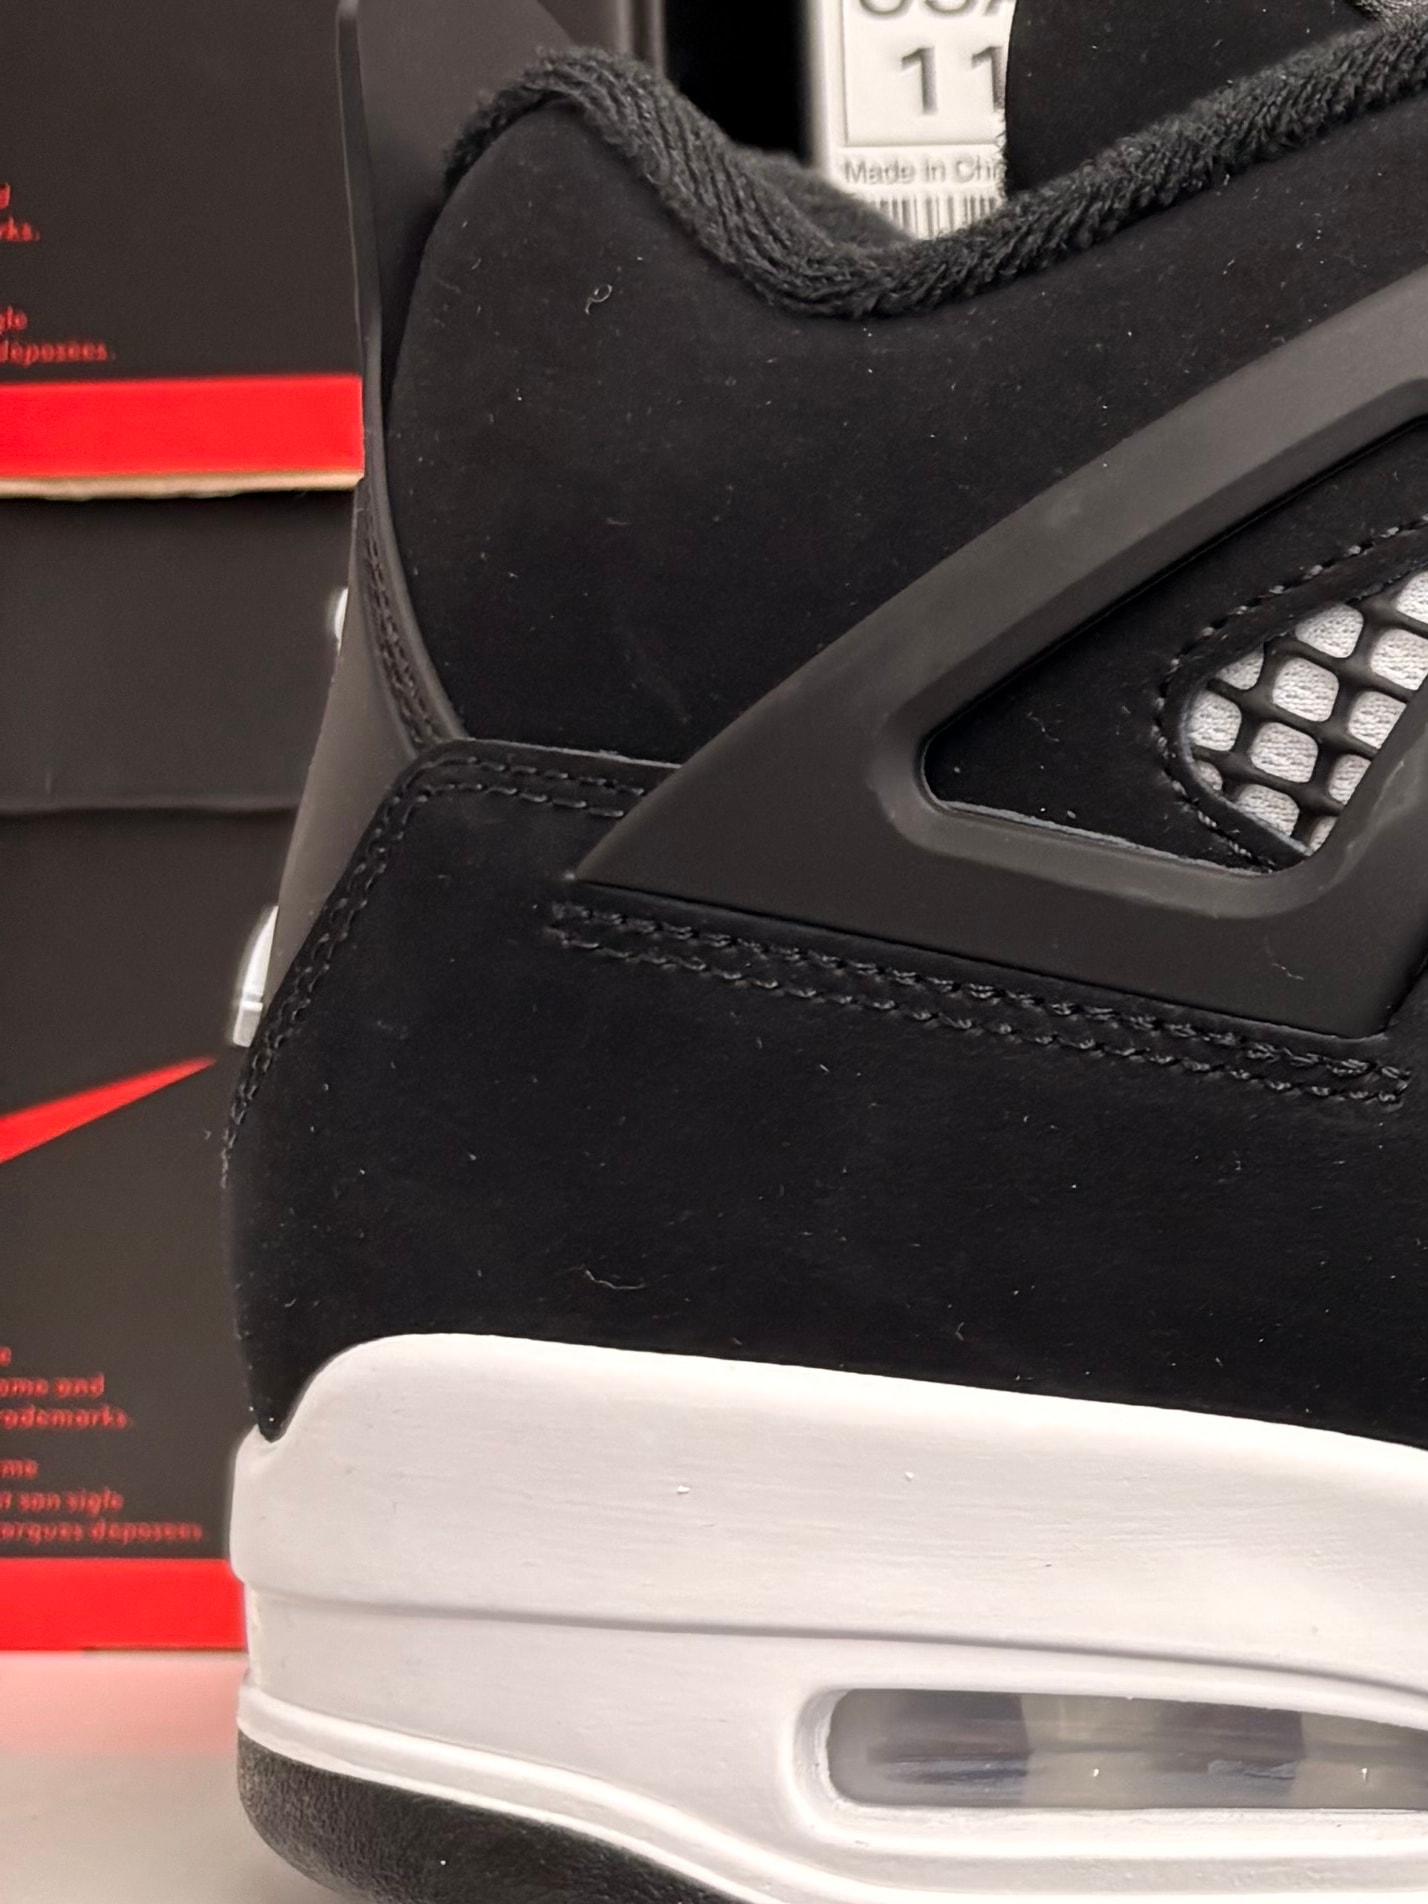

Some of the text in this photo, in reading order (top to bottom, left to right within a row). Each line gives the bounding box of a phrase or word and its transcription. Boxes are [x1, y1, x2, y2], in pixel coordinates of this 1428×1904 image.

[844, 158, 915, 185] Made
[954, 154, 1007, 184] Chin
[55, 1371, 105, 1398] and
[18, 1491, 62, 1513] son
[64, 1485, 125, 1518] sigle
